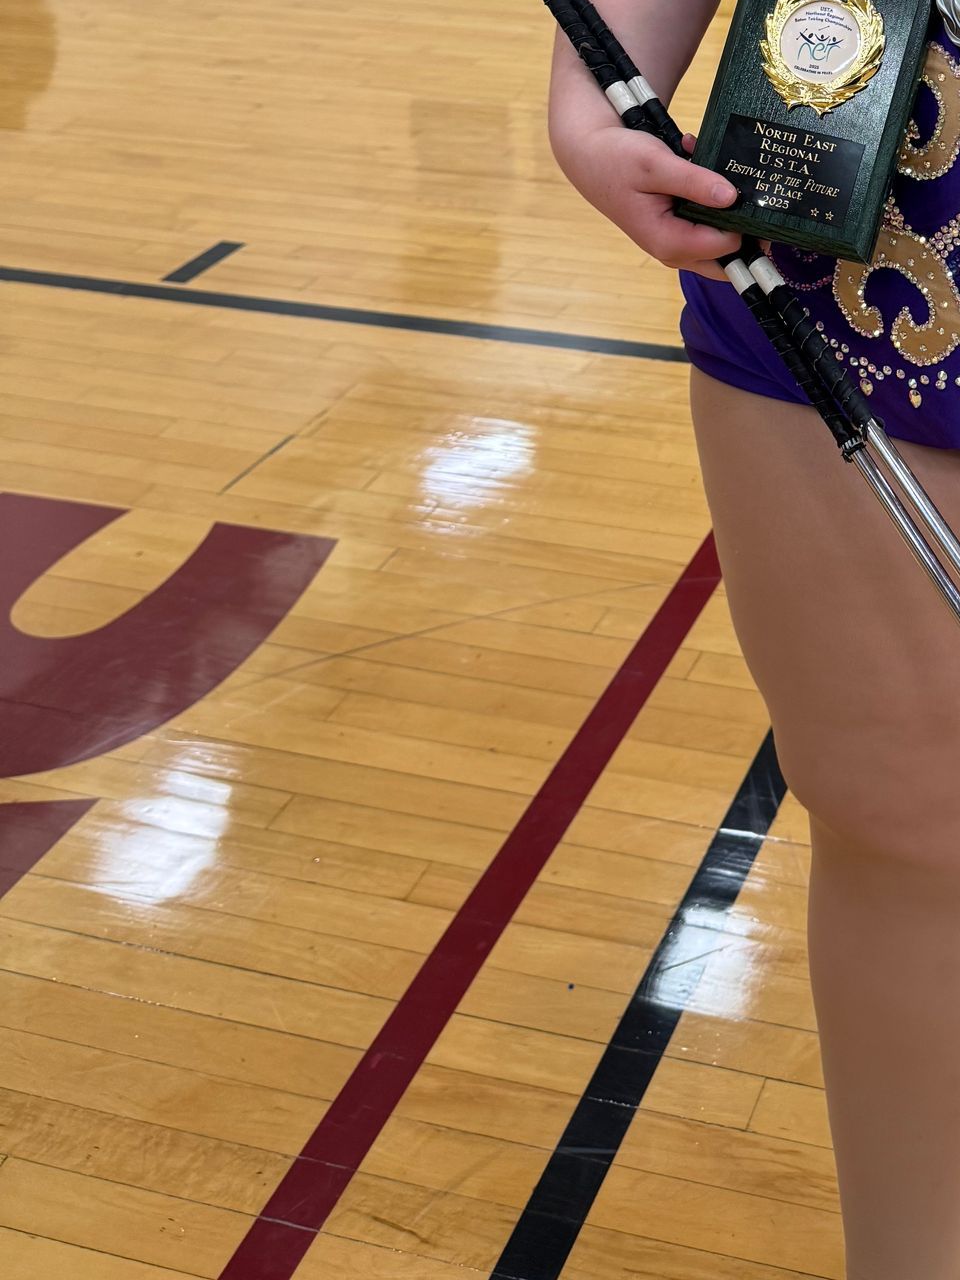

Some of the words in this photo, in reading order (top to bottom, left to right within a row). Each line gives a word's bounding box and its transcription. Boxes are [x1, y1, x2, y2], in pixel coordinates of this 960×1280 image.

[754, 122, 798, 143] NORTH
[803, 134, 838, 152] EAST
[760, 138, 821, 163] REGIONAL
[759, 152, 814, 176] U.S.T.A.
[725, 159, 766, 179] FESTIVAL
[770, 172, 782, 183] OF
[784, 176, 802, 188] THE
[804, 178, 840, 198] FUTURE
[762, 195, 790, 209] 2025
[774, 184, 804, 200] PLACE
